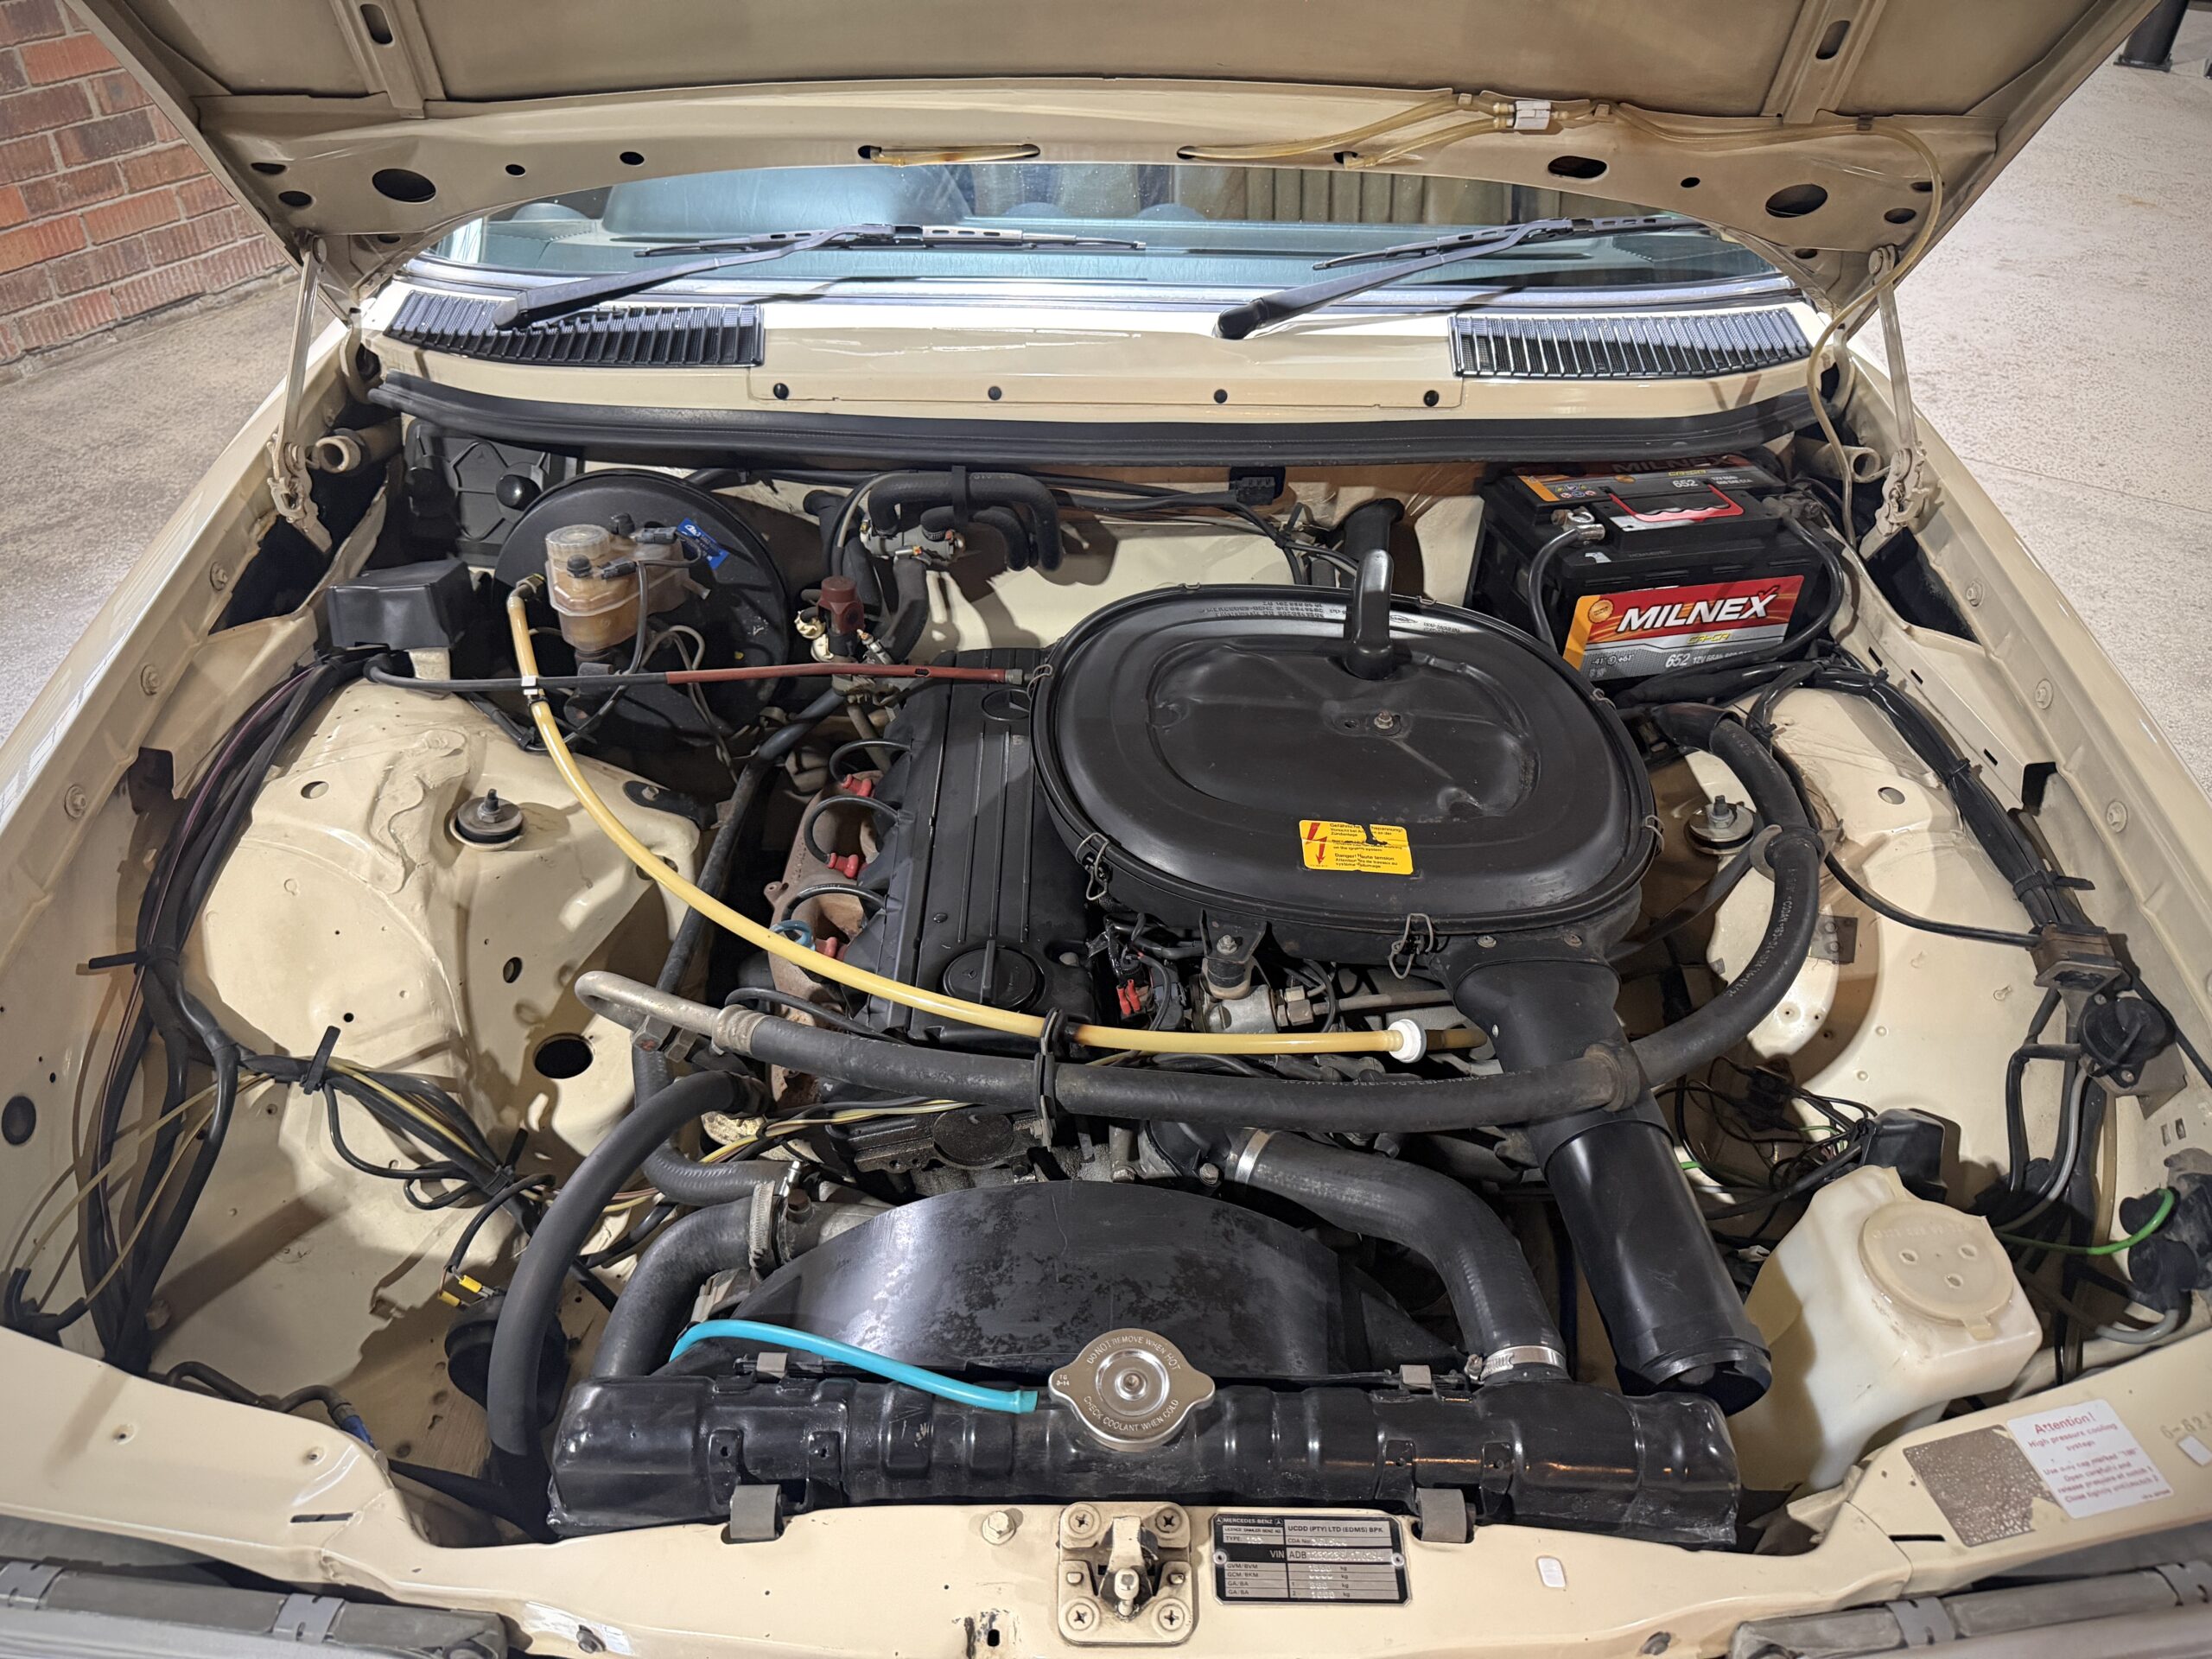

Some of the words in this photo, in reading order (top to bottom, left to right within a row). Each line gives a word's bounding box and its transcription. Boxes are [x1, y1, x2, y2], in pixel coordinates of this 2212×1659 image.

[1672, 479, 1699, 488] 652
[1617, 588, 1778, 632] MILNEX
[1665, 653, 1691, 668] 652
[1096, 1340, 1112, 1359] NOT
[1112, 1335, 1145, 1348] REMOVE
[1145, 1338, 1166, 1356] WHEN
[1164, 1352, 1182, 1372] HOT
[1083, 1395, 1103, 1422] CHECK
[1103, 1416, 1140, 1433] COOLANT
[1141, 1414, 1165, 1432] WHEN
[1162, 1398, 1180, 1420] COLD
[2034, 1412, 2096, 1434] Attention!
[2028, 1438, 2050, 1449] High
[2050, 1430, 2086, 1445] pressure
[2086, 1422, 2119, 1435] cooling
[2043, 1467, 2059, 1476] Use
[1270, 1549, 1285, 1559] VIN
